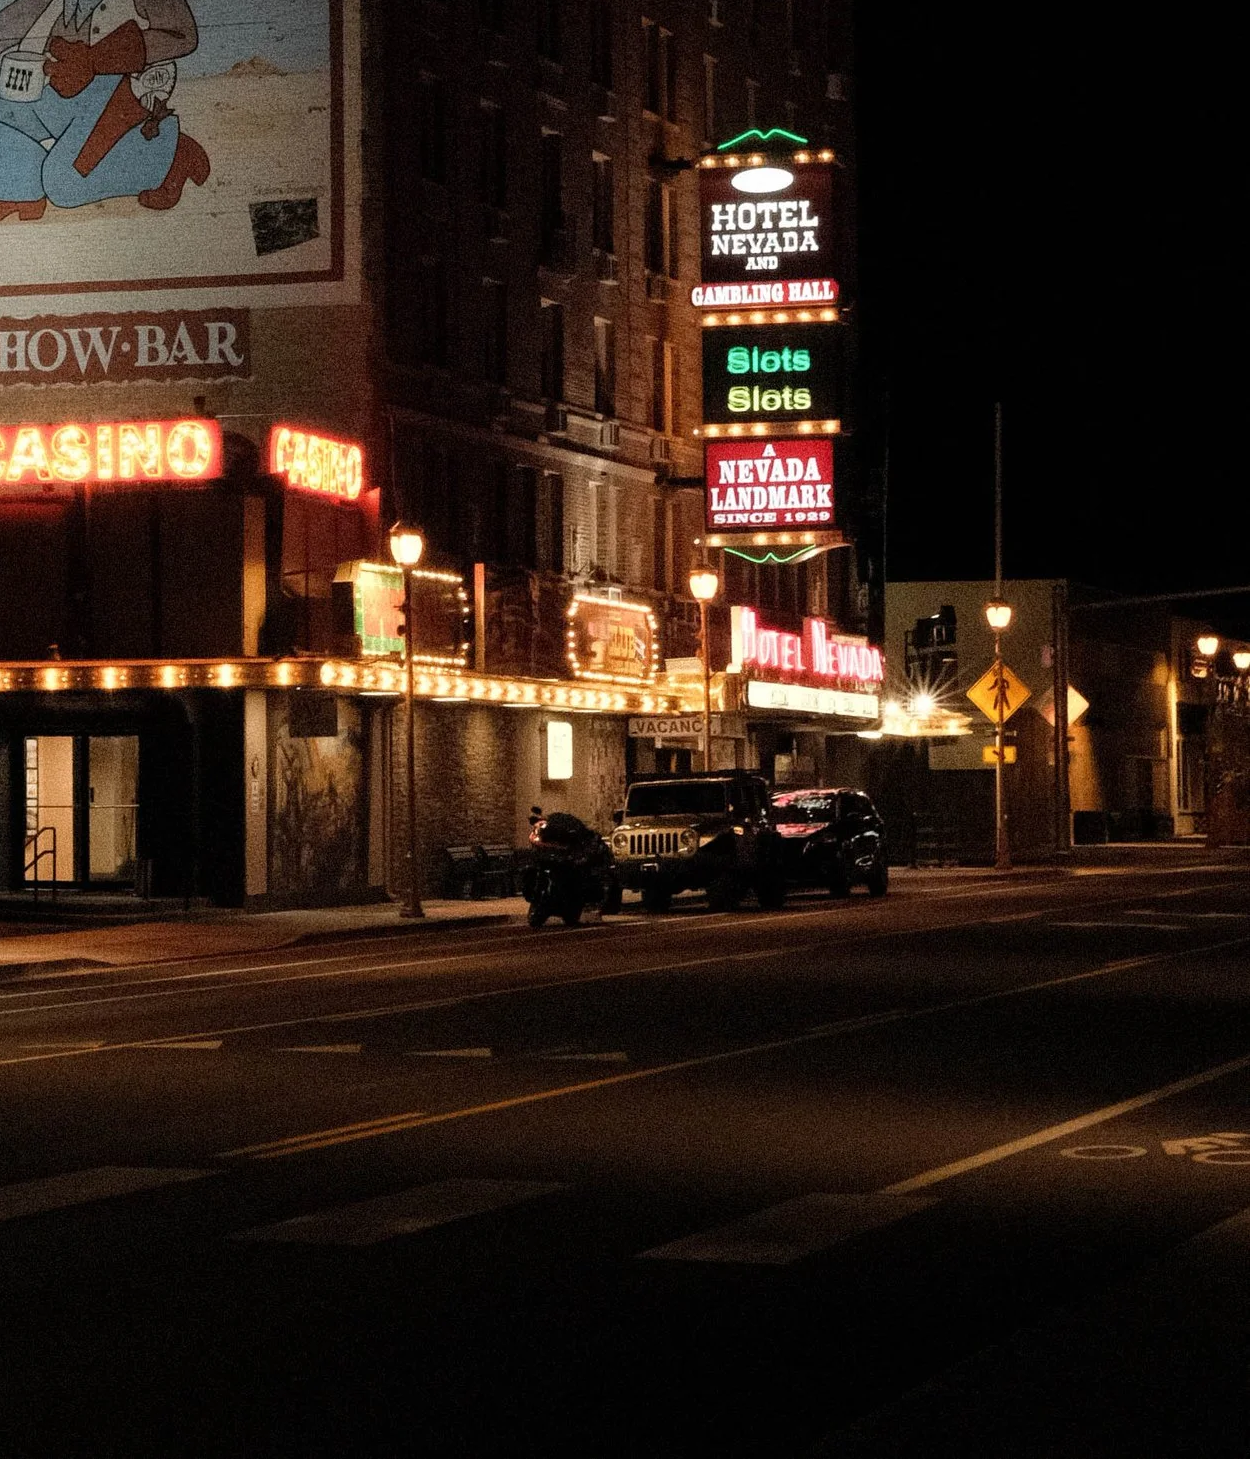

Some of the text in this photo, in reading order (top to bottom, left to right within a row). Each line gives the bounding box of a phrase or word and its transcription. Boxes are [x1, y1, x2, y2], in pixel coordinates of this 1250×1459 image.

[5, 67, 33, 91] HN
[711, 200, 819, 231] HOTEL
[711, 230, 819, 256] NEVADA
[745, 255, 779, 270] AND
[691, 280, 834, 307] GAMBLING HALL
[727, 346, 811, 374] Slots
[727, 385, 812, 412] Slots
[275, 428, 363, 500] CASINO
[762, 444, 776, 457] A
[718, 457, 821, 484] NEVADA
[710, 483, 833, 511] LANDMARK
[713, 511, 831, 524] SINCE 1929
[741, 606, 884, 681] HOTEL NEVADA
[635, 718, 706, 734] VACANC
